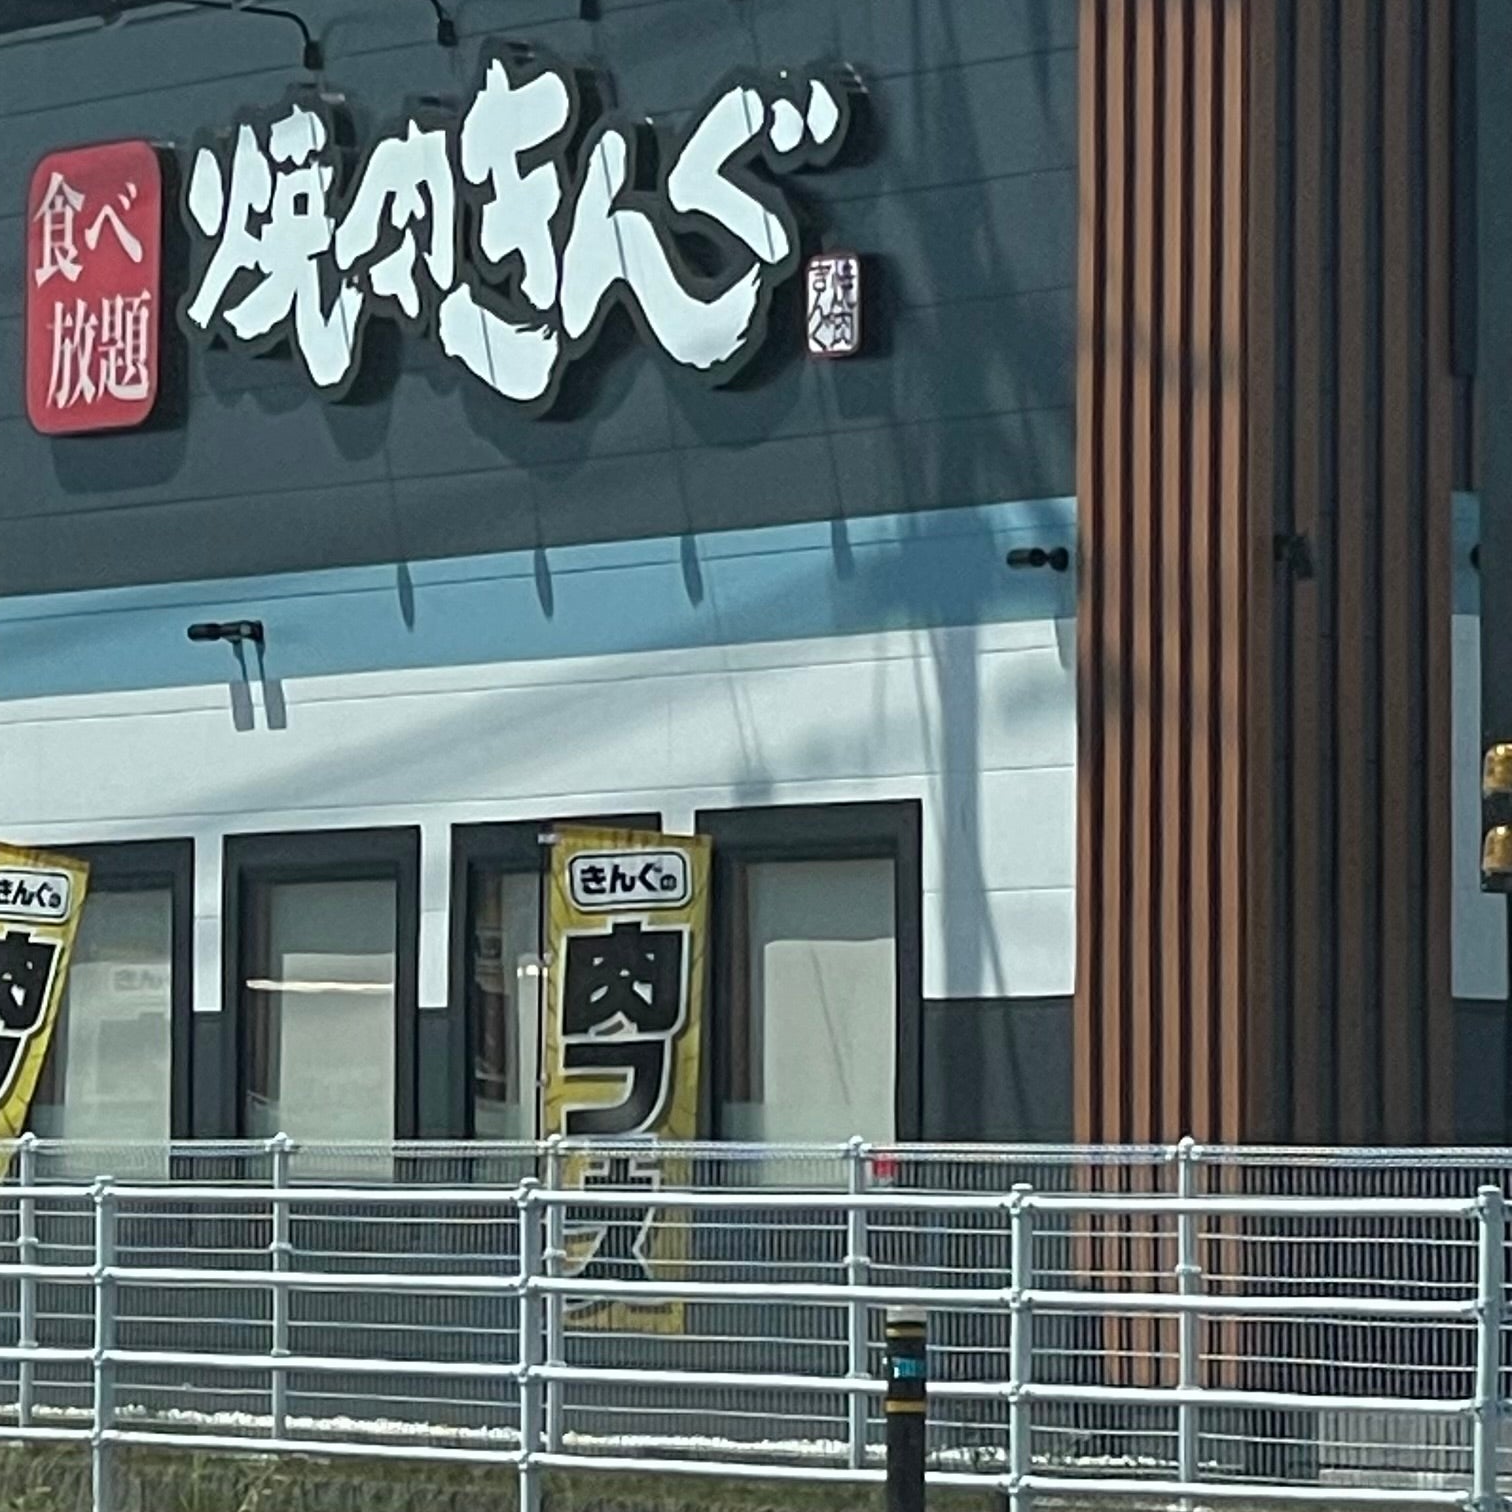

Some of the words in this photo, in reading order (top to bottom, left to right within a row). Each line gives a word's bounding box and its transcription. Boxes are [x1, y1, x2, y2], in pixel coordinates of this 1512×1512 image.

[33, 171, 145, 288] 食べ
[186, 56, 840, 402] 焼肉きんぐ
[44, 288, 153, 409] 放題
